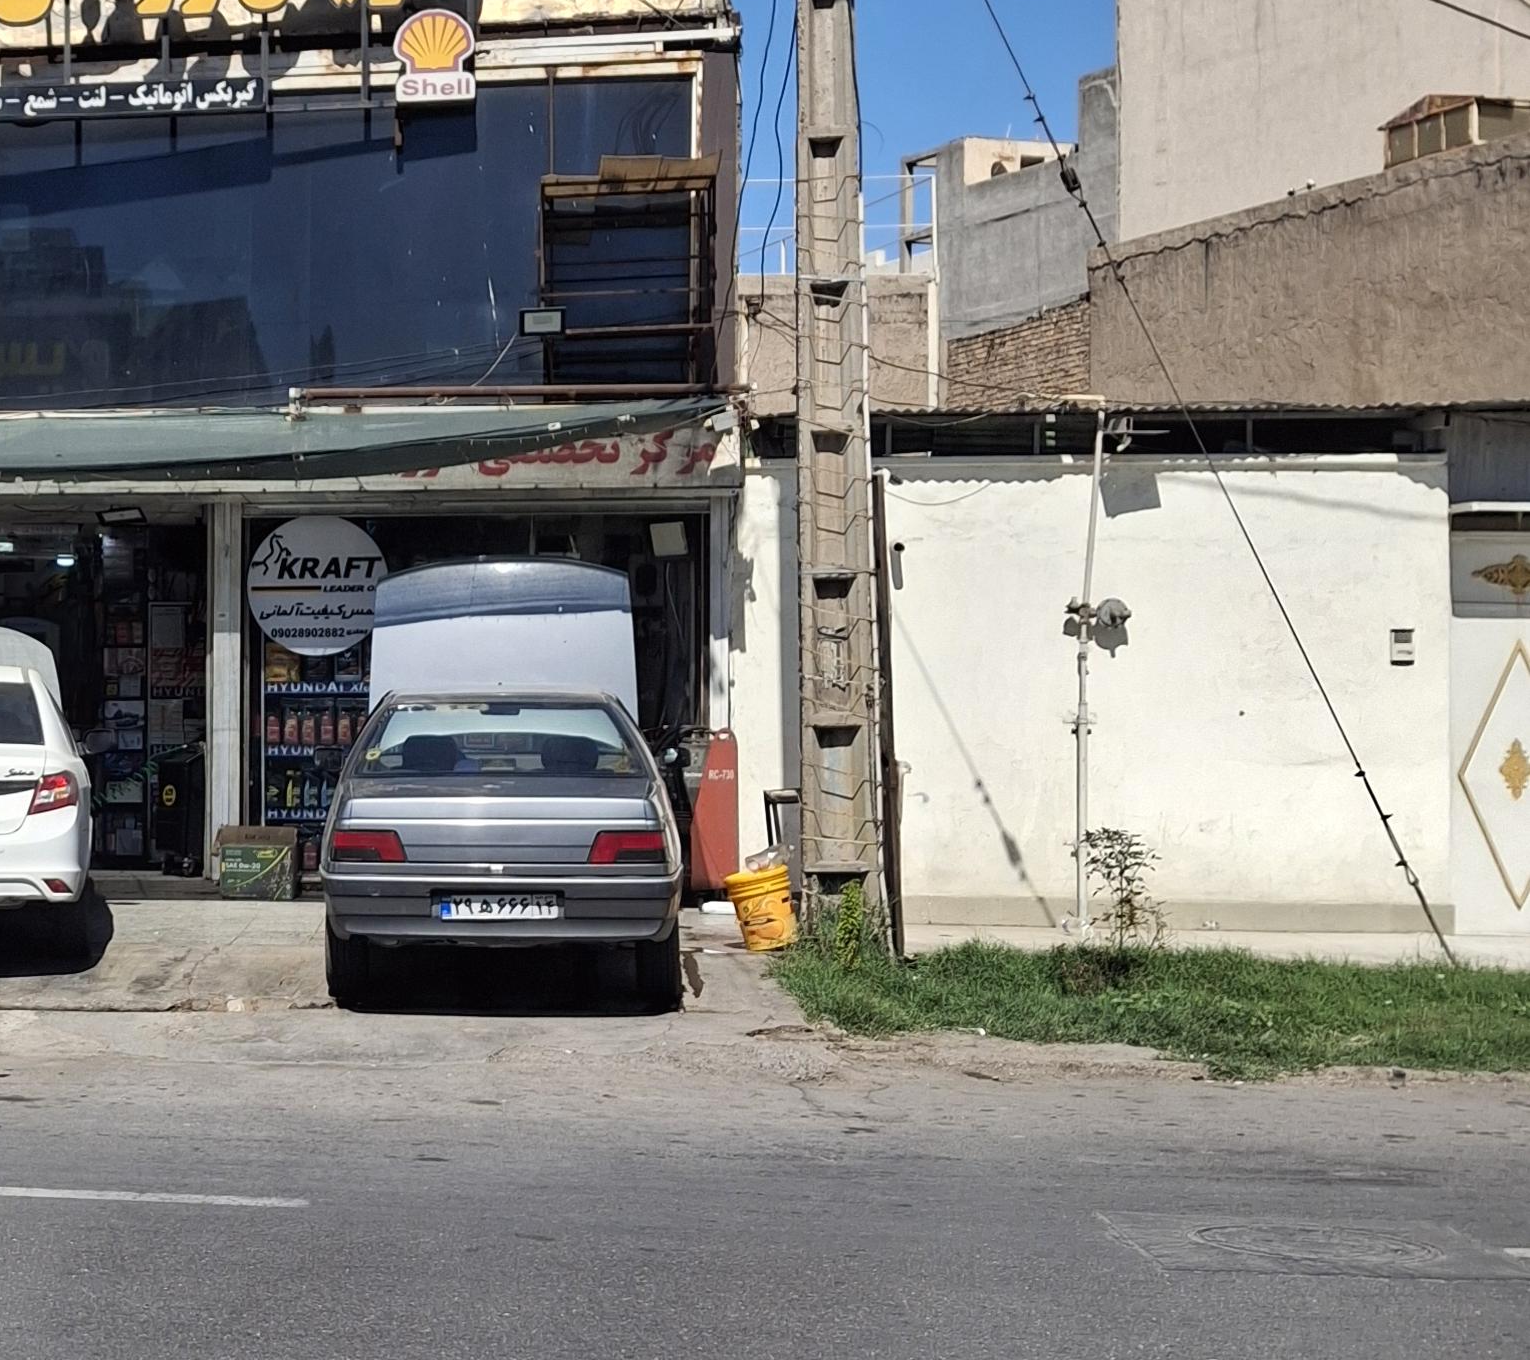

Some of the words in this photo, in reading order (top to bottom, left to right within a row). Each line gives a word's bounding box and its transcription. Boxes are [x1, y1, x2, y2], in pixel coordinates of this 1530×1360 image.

[196, 80, 257, 110] گیربکس
[401, 78, 470, 95] Shell
[23, 88, 57, 116] شمع
[78, 85, 107, 109] لنت
[128, 81, 193, 111] اتوماتیک
[278, 557, 383, 579] KRAFT
[323, 584, 365, 593] LEADER
[259, 602, 304, 620] آلمانی
[299, 603, 346, 620] کیفیت
[267, 682, 345, 693] HYUNDAI
[267, 745, 314, 756] HYUN
[267, 808, 327, 819] HYUND
